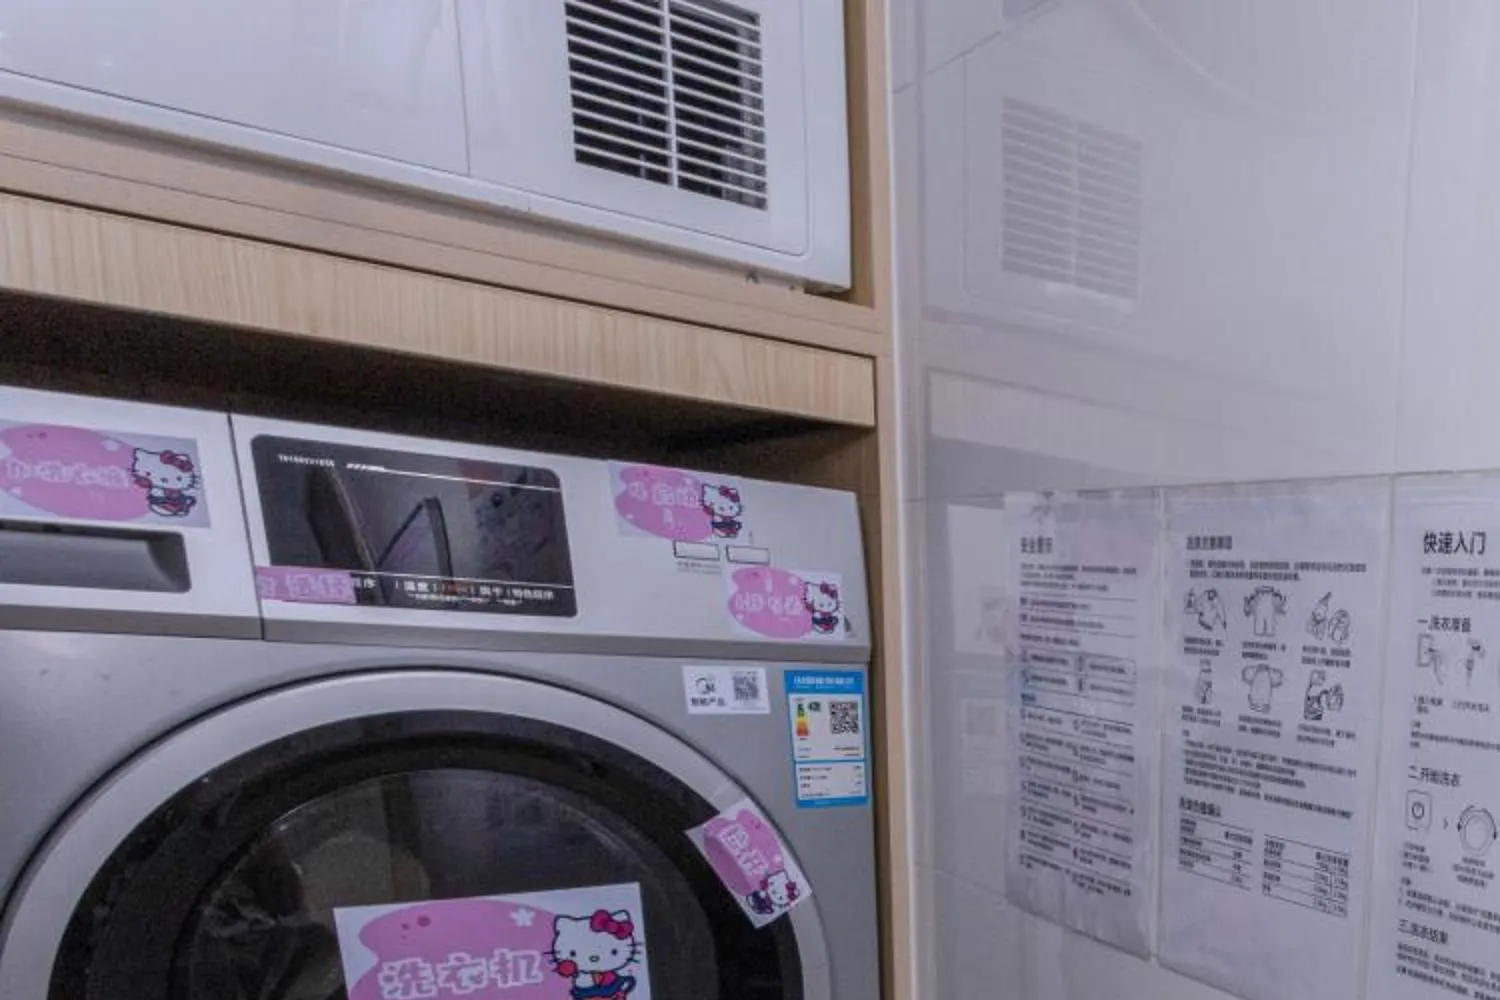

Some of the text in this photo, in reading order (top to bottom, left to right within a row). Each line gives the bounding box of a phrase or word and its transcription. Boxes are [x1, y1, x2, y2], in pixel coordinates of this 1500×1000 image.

[1423, 531, 1487, 556] 快速入门
[379, 949, 544, 1000] 洗衣机
